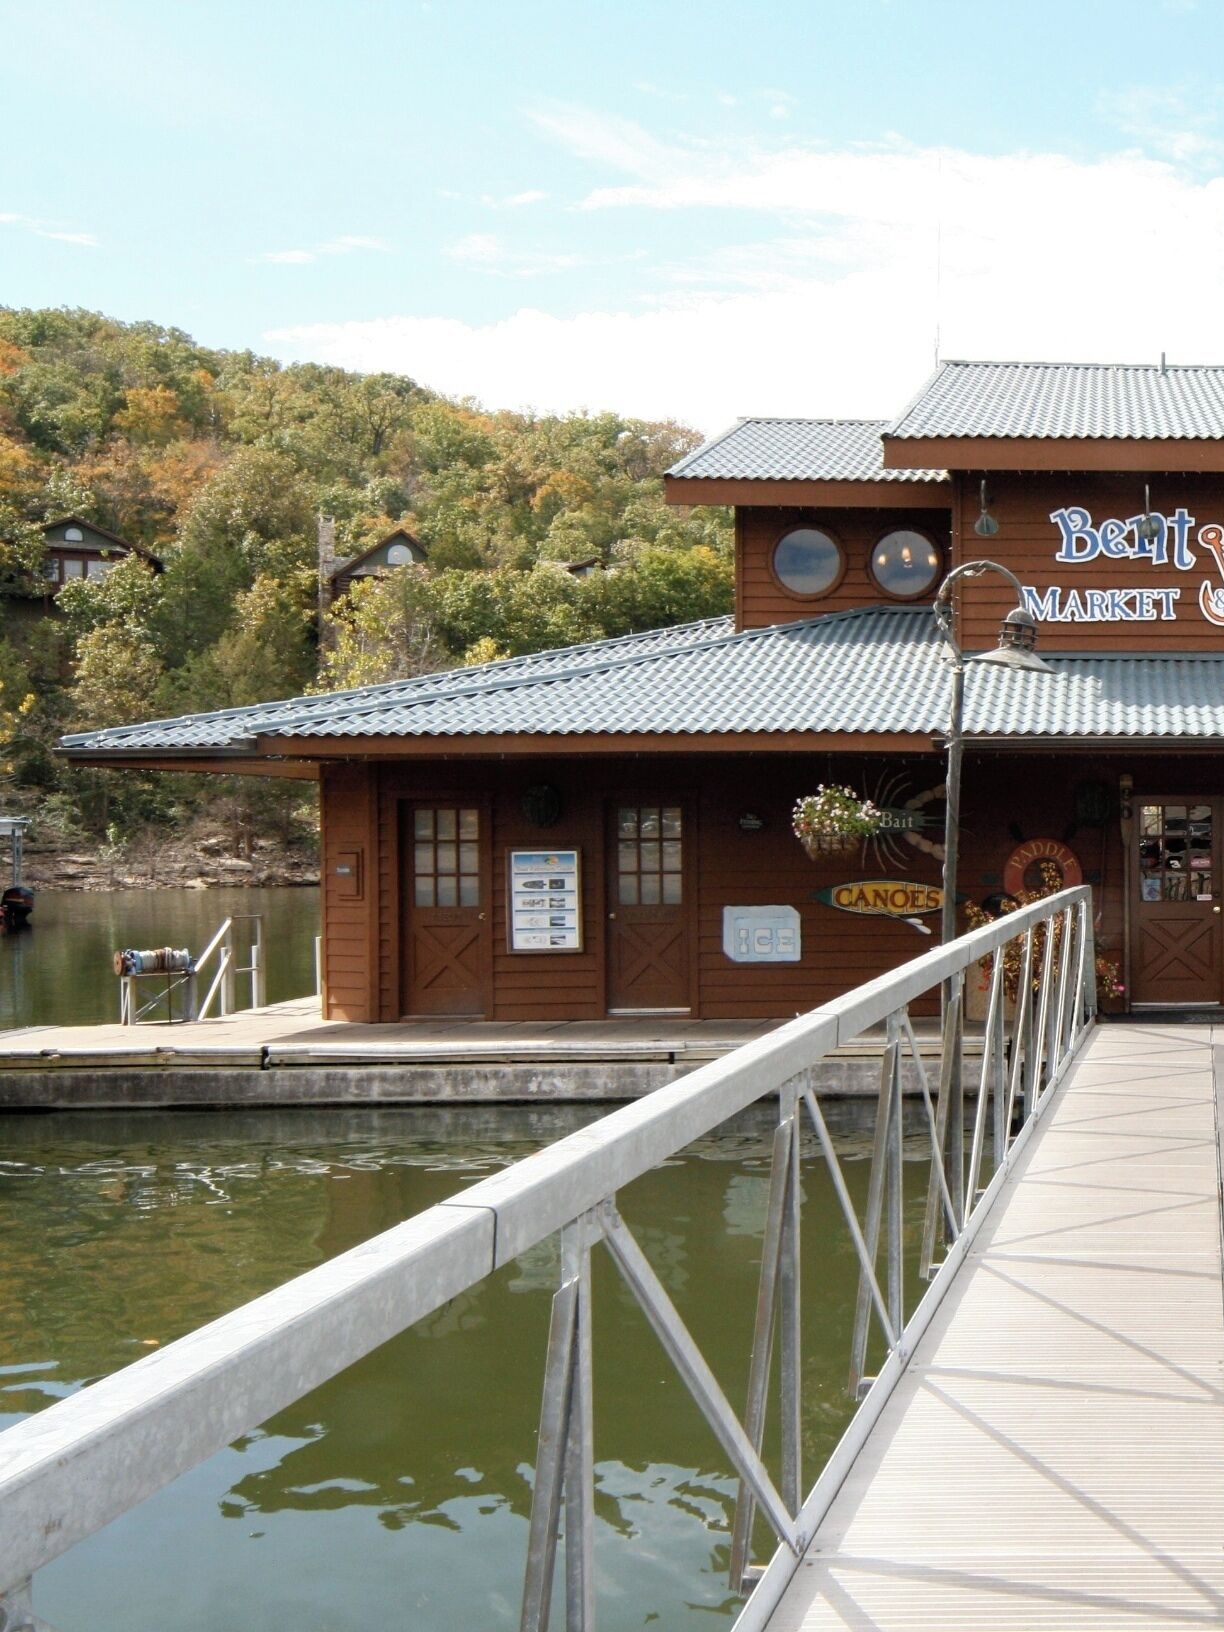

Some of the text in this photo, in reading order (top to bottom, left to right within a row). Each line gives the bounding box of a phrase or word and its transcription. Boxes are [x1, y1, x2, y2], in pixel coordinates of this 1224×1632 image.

[1050, 507, 1196, 570] Bent
[1022, 586, 1180, 622] MARKET
[880, 811, 913, 828] Bait
[1011, 841, 1078, 871] PADDLE
[835, 887, 941, 909] CANOES
[738, 928, 795, 955] ICE
